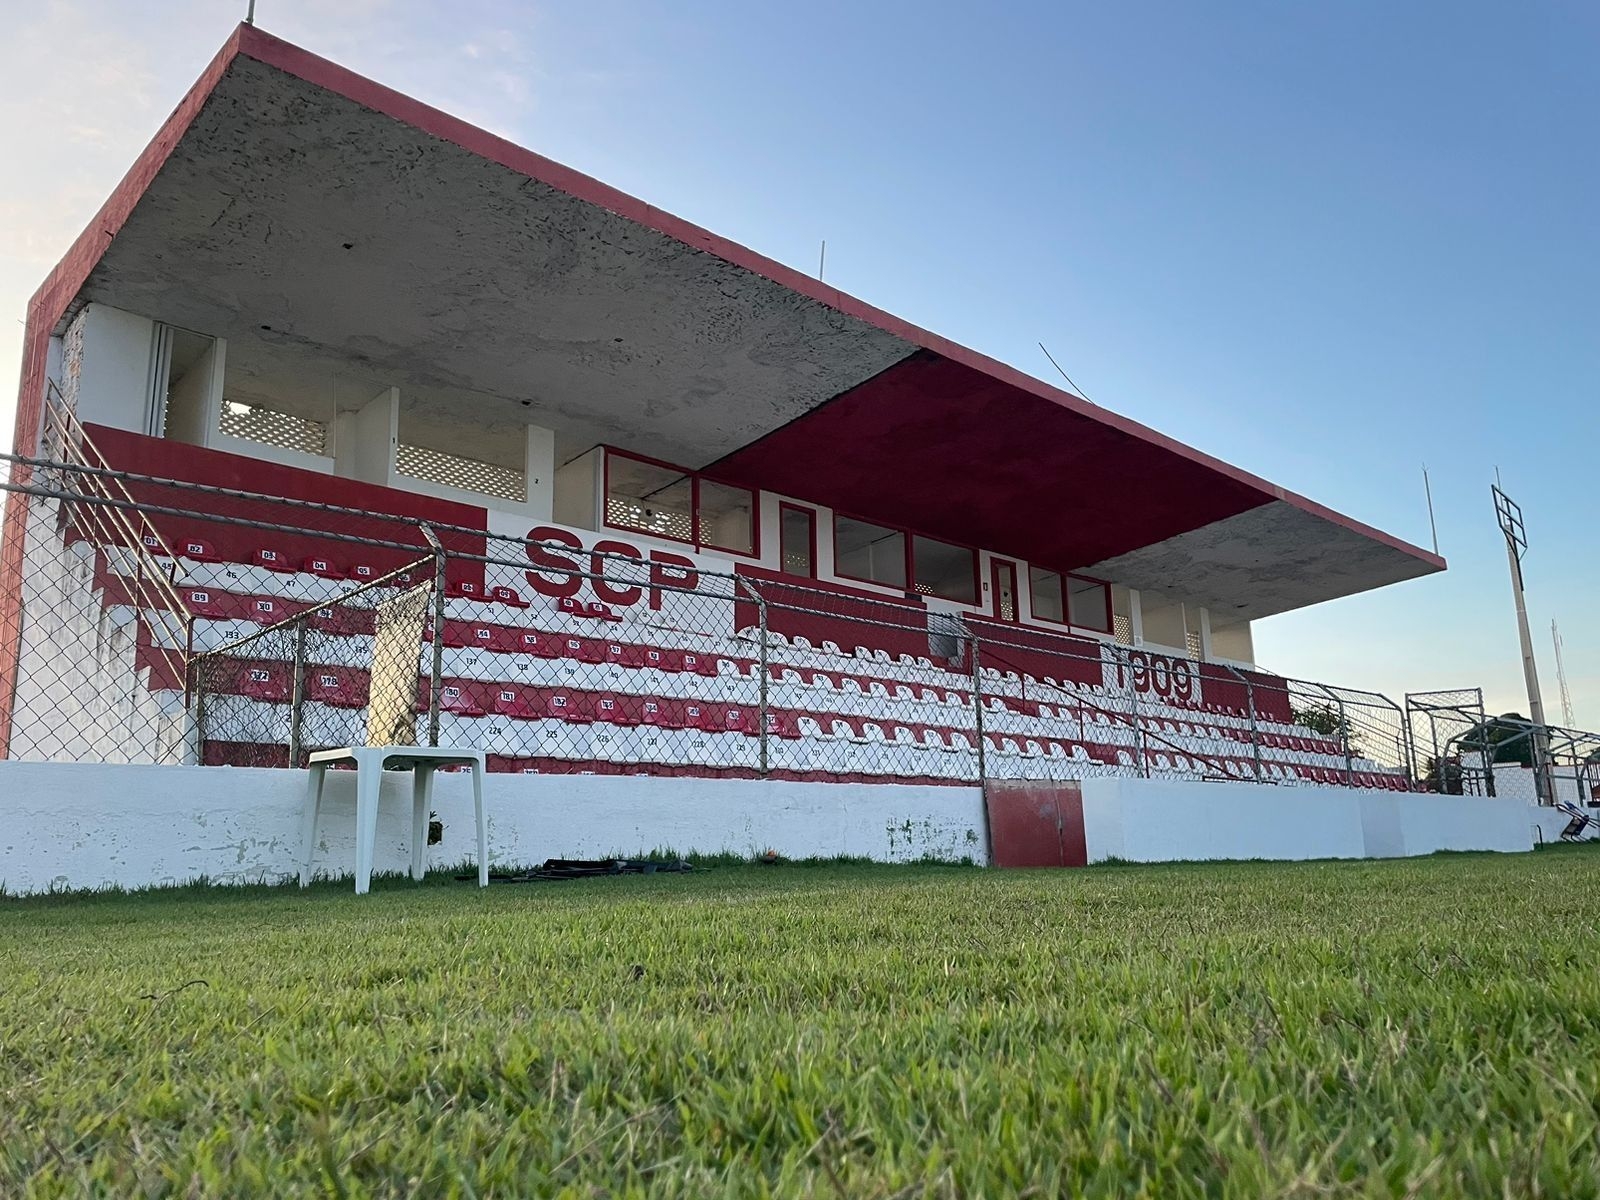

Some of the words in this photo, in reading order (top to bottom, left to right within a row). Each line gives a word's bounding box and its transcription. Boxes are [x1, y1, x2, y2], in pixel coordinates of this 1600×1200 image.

[190, 545, 201, 553] 02
[162, 562, 172, 570] 45
[315, 562, 324, 570] 04
[525, 526, 699, 611] SCP
[226, 571, 237, 579] 46
[194, 593, 206, 602] 89
[225, 631, 239, 639] 133
[466, 657, 477, 665] 137
[1112, 651, 1192, 700] 1909
[445, 688, 458, 697] 180
[502, 692, 514, 701] 181
[489, 727, 501, 735] 224
[546, 731, 557, 739] 225
[598, 735, 609, 743] 226
